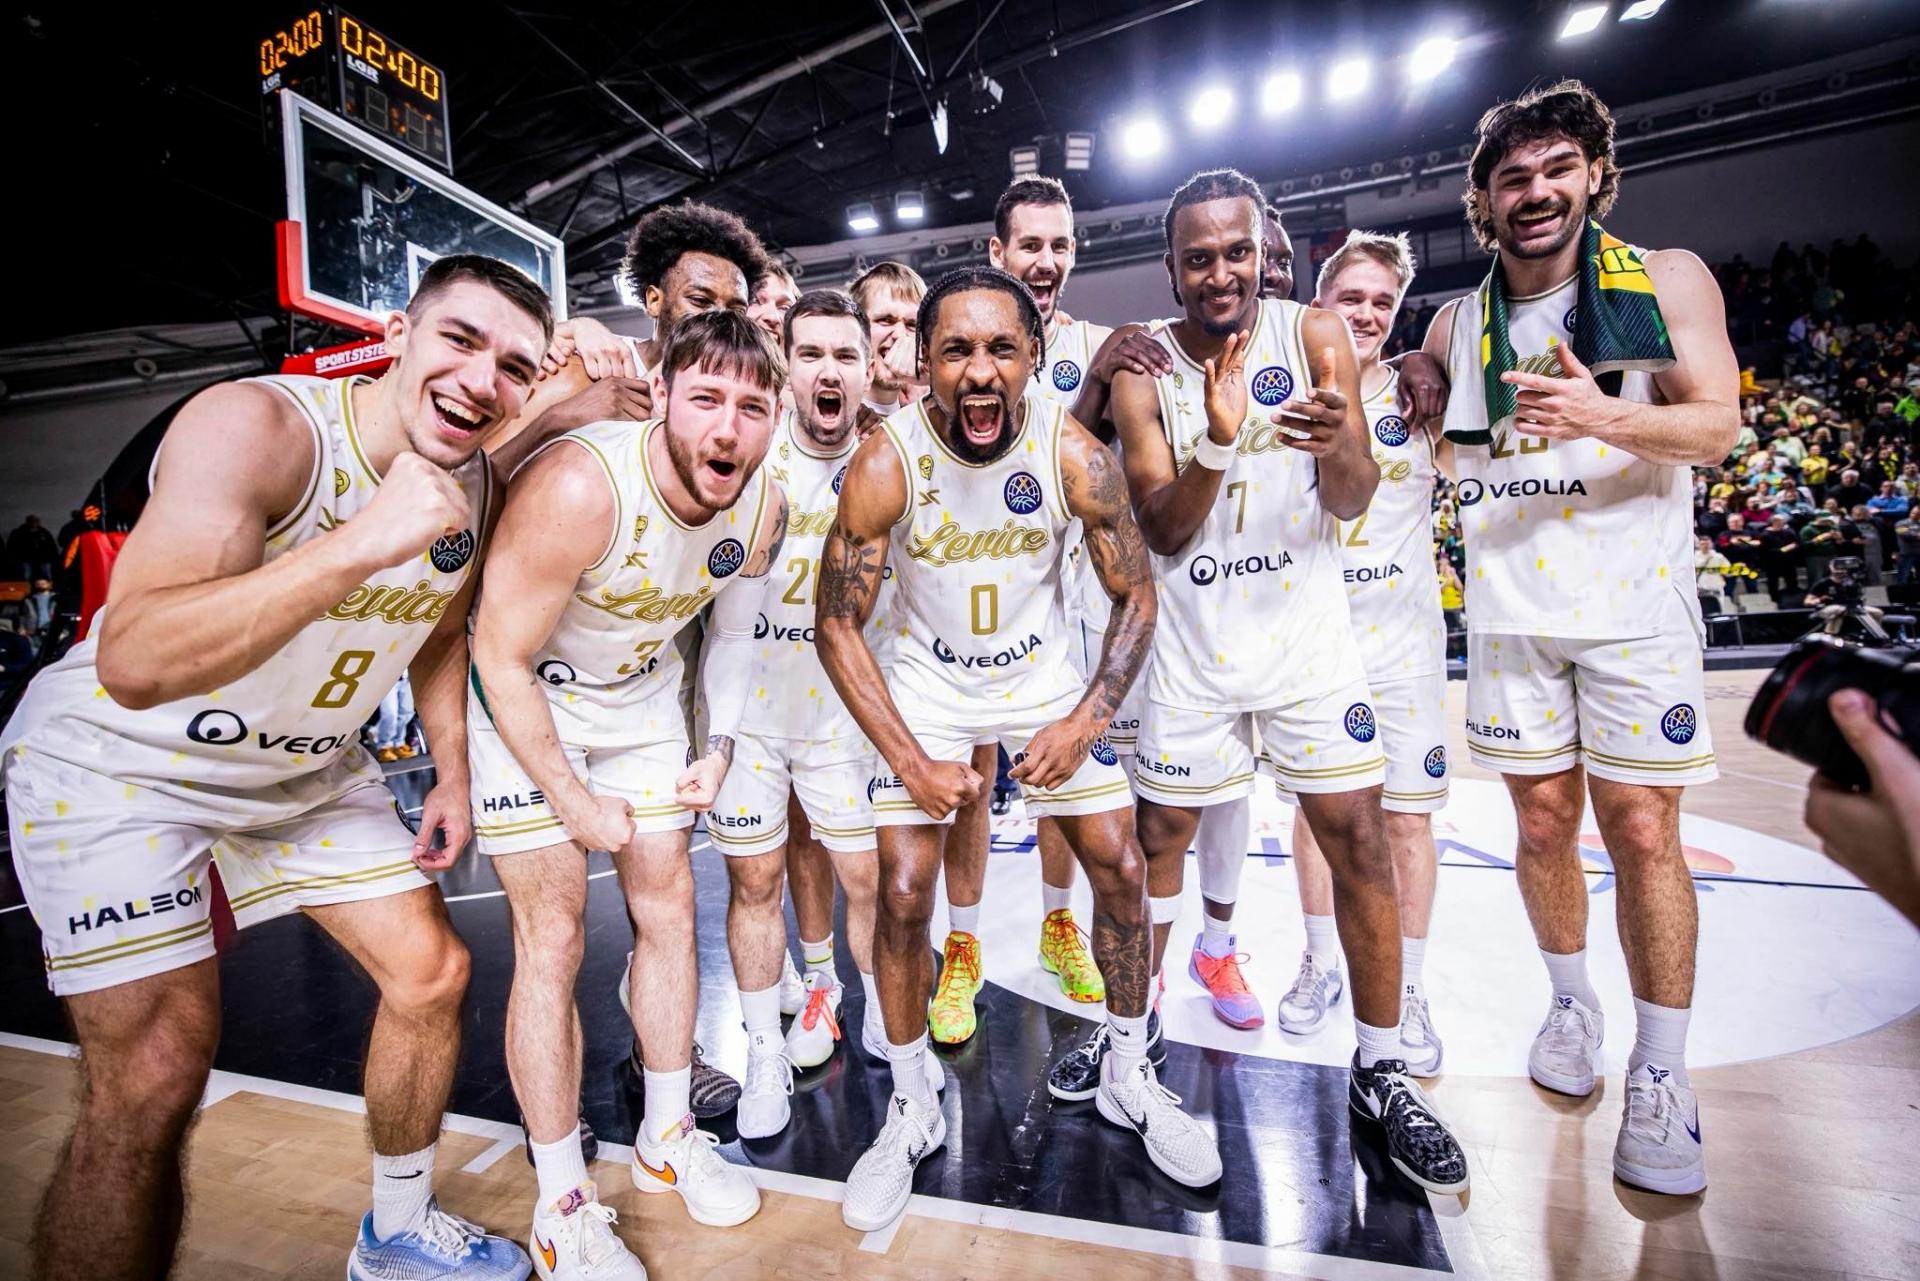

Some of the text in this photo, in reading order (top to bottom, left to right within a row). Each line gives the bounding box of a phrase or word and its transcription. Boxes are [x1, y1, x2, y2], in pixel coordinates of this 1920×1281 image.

[260, 10, 323, 75] 02:00
[341, 16, 439, 100] 02:00
[1227, 480, 1247, 533] 7
[1490, 479, 1588, 499] VEOLIA
[905, 519, 1050, 568] Levice
[1221, 550, 1294, 579] VEOLIA
[1343, 563, 1404, 582] EOLIA
[576, 586, 718, 624] Levi
[970, 583, 999, 636] 0
[773, 624, 816, 642] VEO
[958, 633, 1043, 669] VEOLIA
[617, 639, 665, 675] 3
[311, 650, 376, 708] 8
[259, 732, 347, 755] VEOL
[1465, 718, 1520, 741] HALEON
[1135, 750, 1190, 777] HALEON
[483, 790, 545, 813] HALE
[708, 811, 762, 827] ALEON
[68, 886, 203, 935] HALEON
